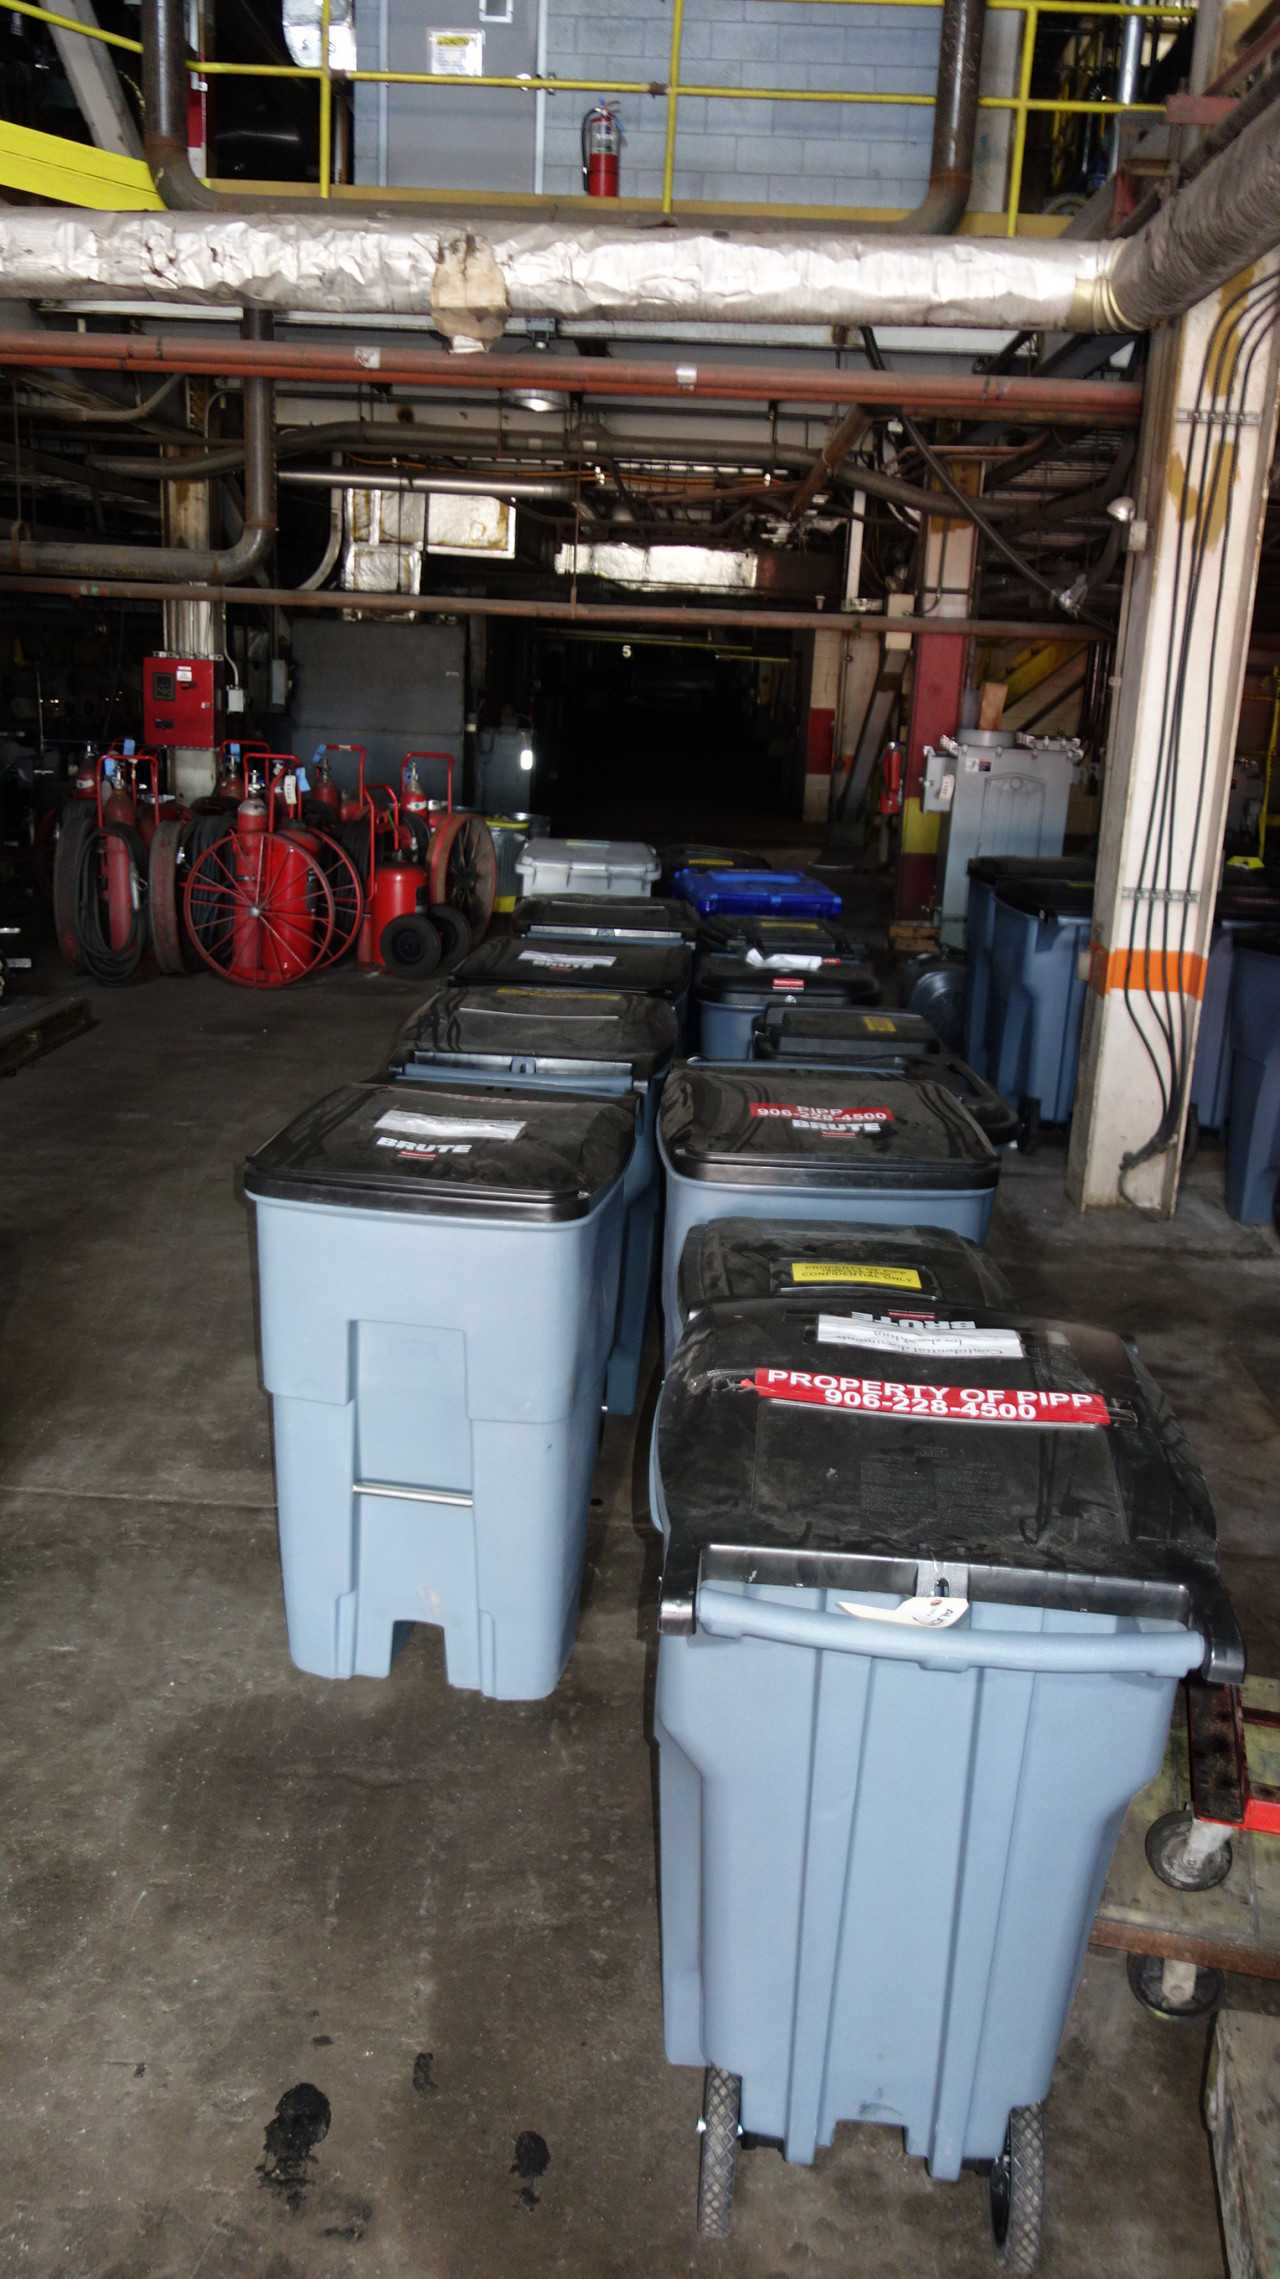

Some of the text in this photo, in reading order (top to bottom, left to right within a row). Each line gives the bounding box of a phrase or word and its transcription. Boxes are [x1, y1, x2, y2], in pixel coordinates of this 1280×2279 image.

[756, 1108, 888, 1122] 906-228-4500
[791, 1119, 882, 1132] BRUTE
[376, 1136, 473, 1153] BRUTE
[767, 1369, 1093, 1409] PROPERTY OF PIPP
[824, 1389, 1038, 1420] 906-228-4500
